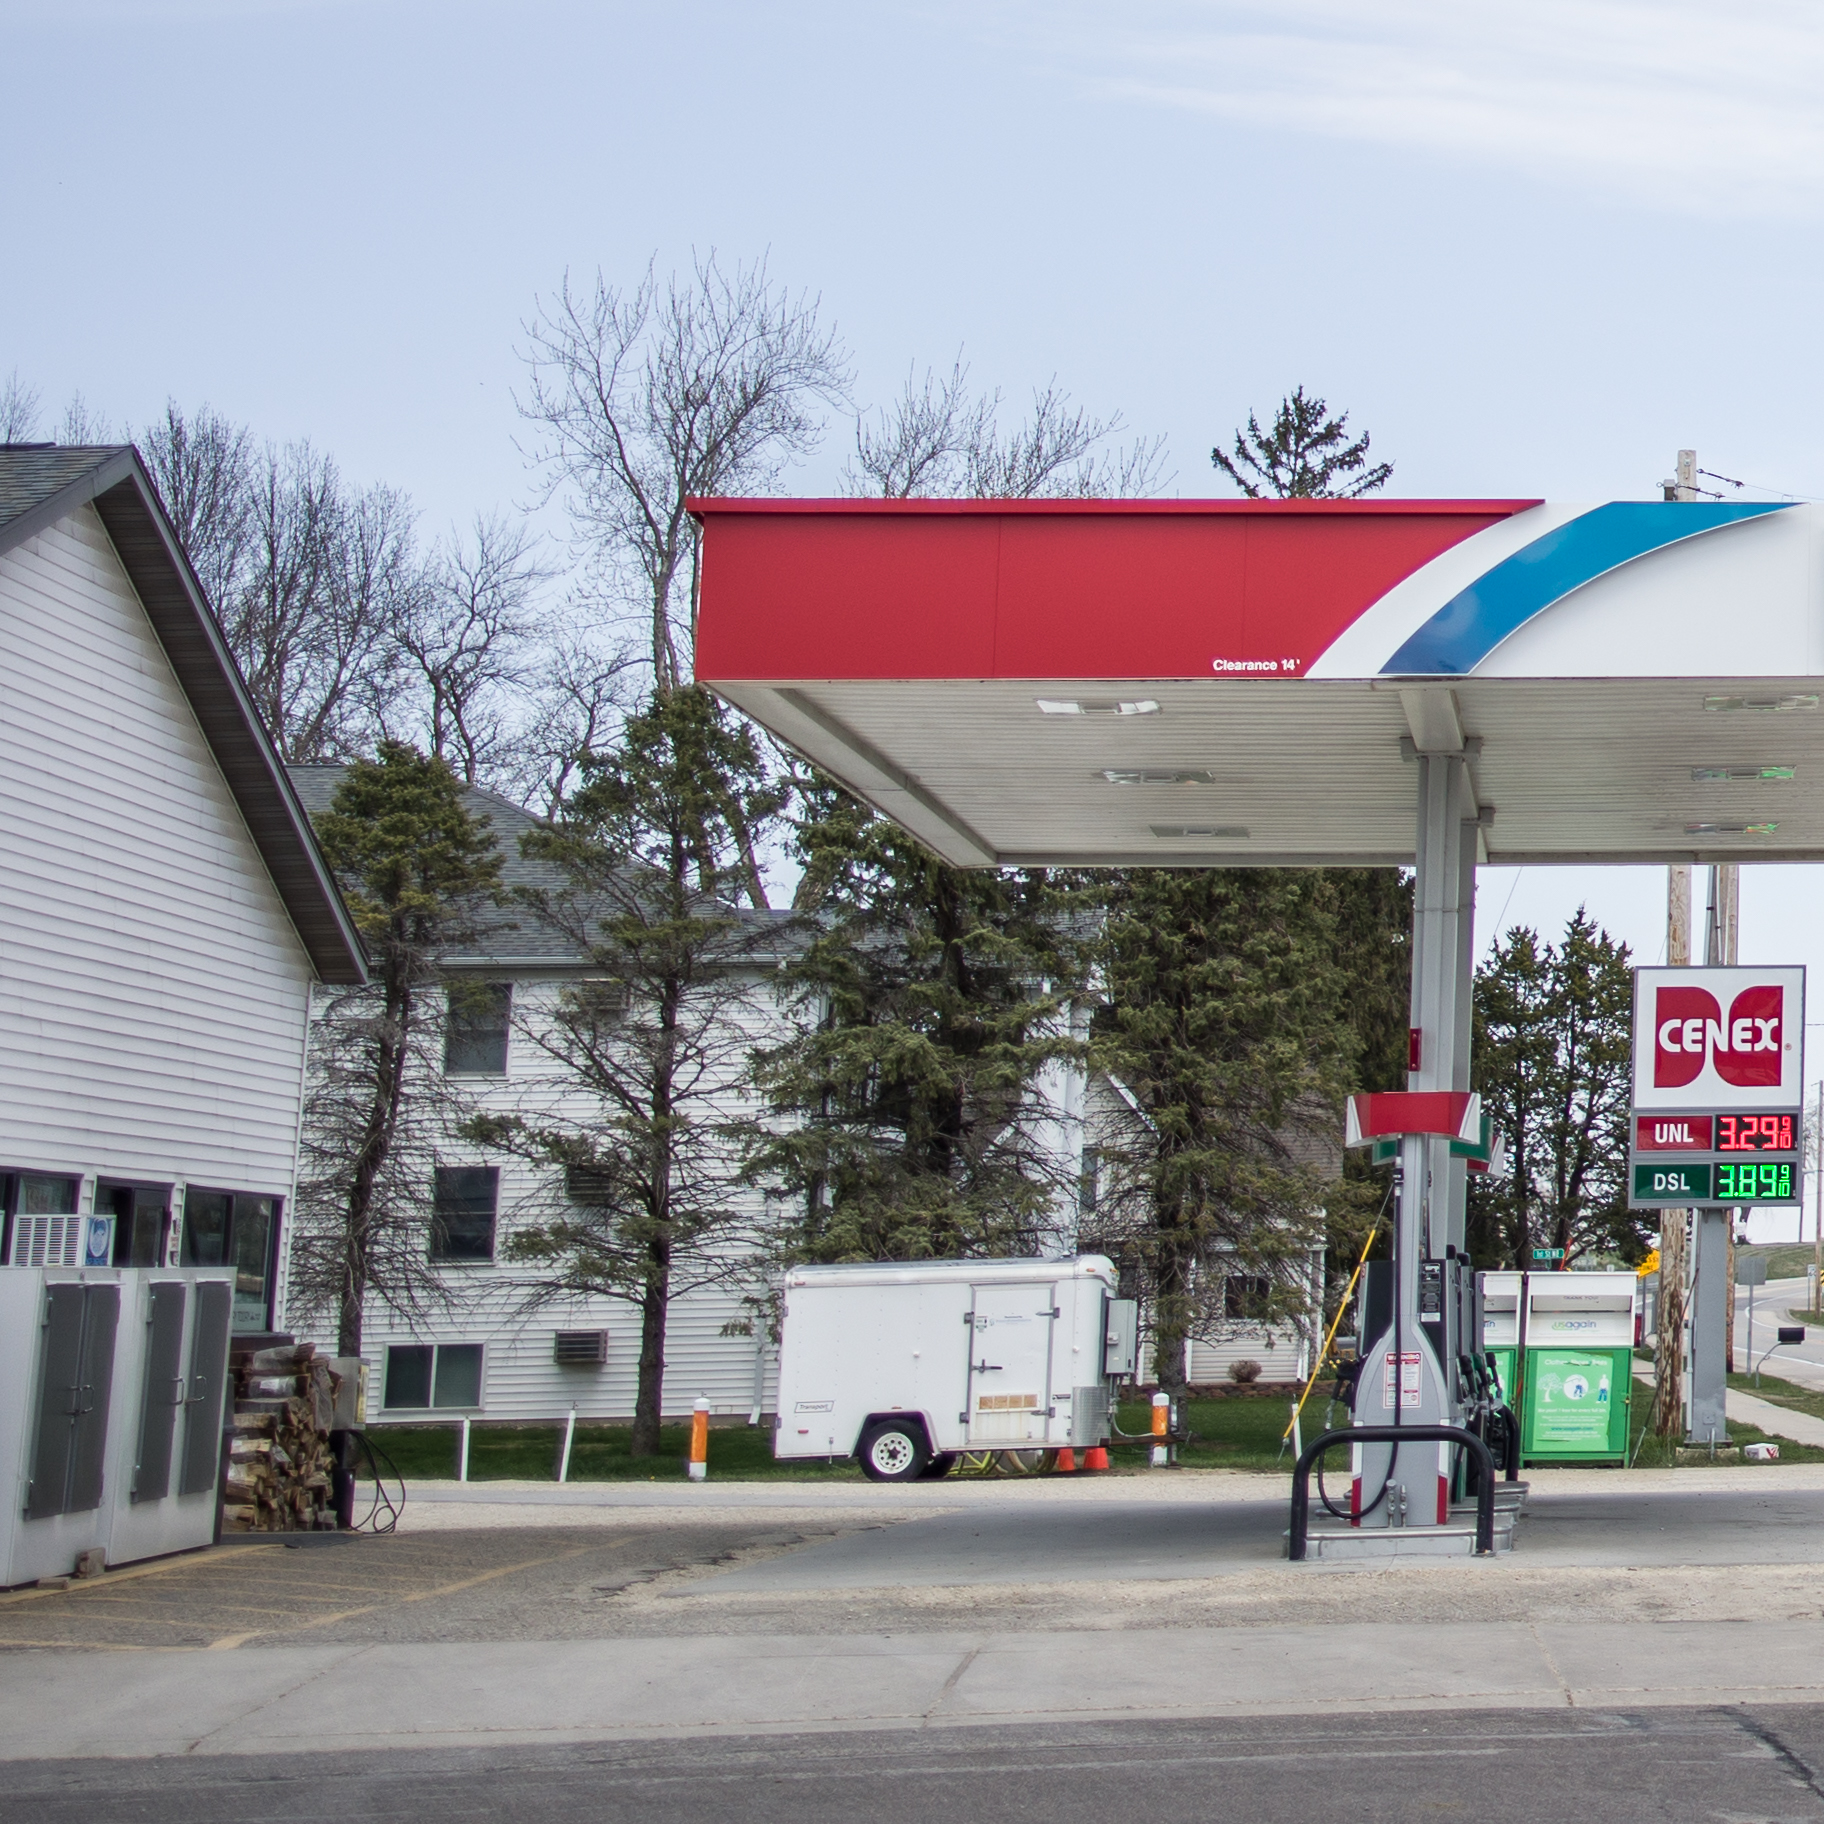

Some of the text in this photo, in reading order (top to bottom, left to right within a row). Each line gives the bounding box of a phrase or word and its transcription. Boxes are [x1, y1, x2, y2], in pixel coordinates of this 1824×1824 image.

[1213, 659, 1278, 671] Clearance
[1658, 1017, 1780, 1053] CENEX
[1655, 1123, 1694, 1144] UNL
[1720, 1117, 1778, 1149] 3.29
[1653, 1173, 1691, 1191] DSL
[1719, 1165, 1777, 1197] 3.89
